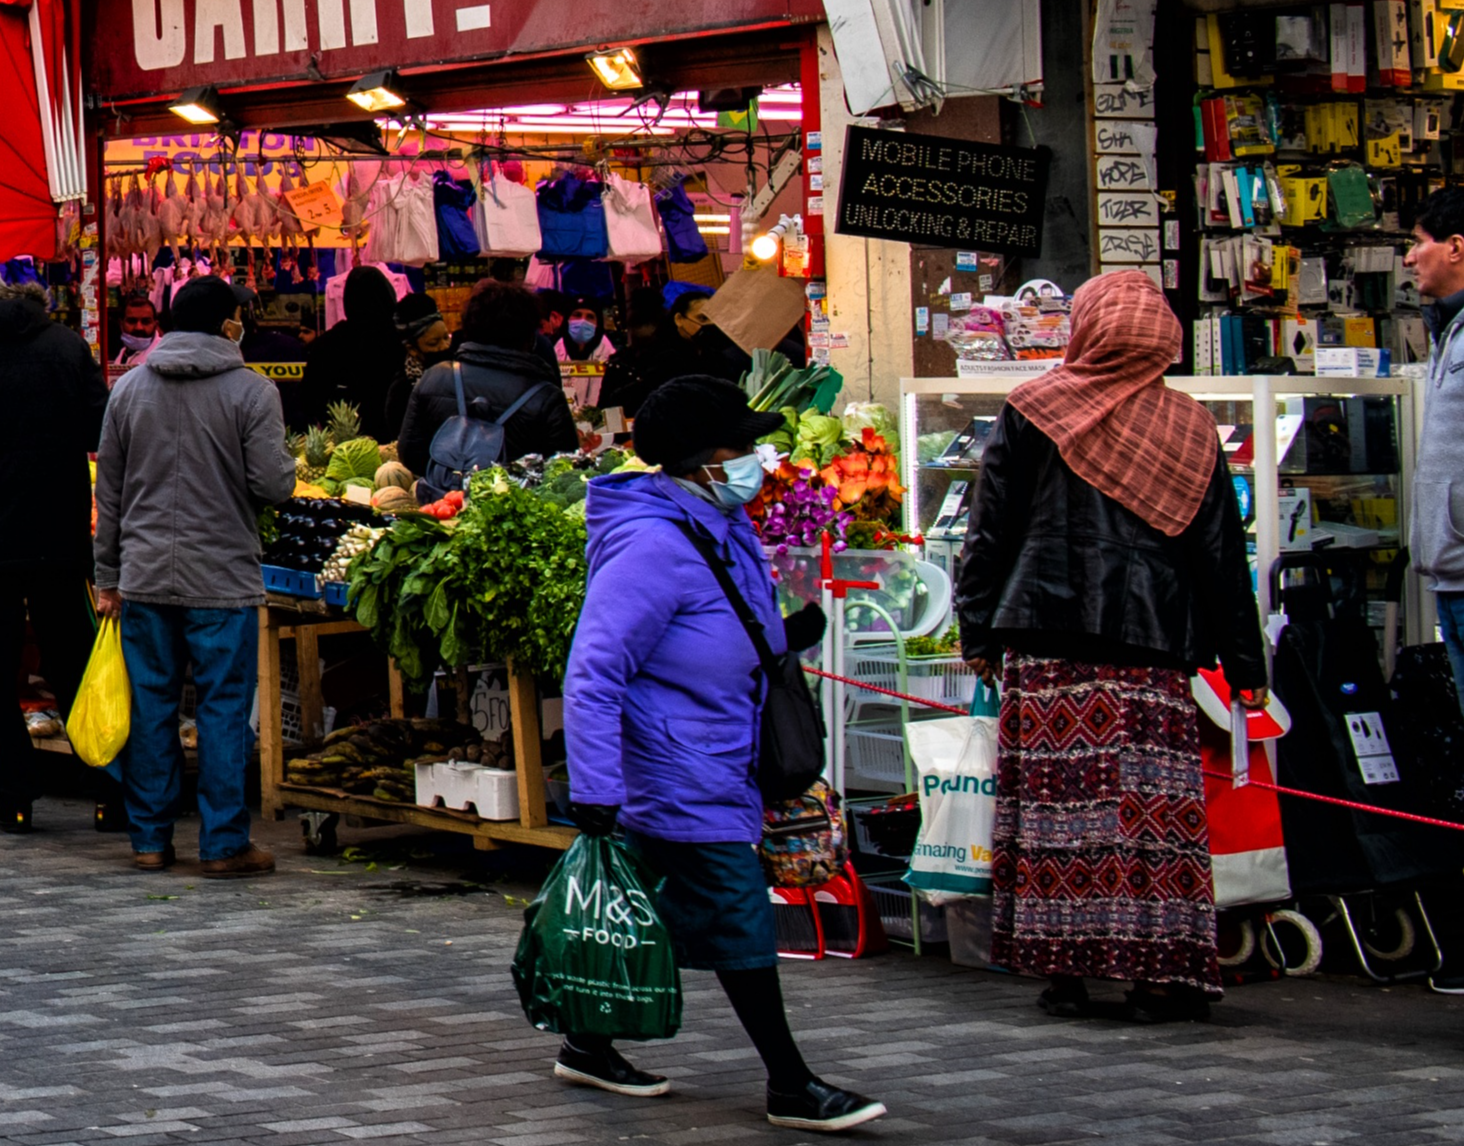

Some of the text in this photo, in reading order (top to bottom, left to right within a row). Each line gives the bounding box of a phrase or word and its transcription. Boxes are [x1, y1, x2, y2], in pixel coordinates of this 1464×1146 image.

[132, 130, 314, 153] BRIXTON
[862, 137, 1036, 182] MOBILE PHONE
[861, 172, 1029, 214] ACCESSORIES
[845, 203, 1037, 248] UNLOCKING & REPAIR
[564, 874, 654, 927] M&S
[583, 927, 637, 949] FOOD
